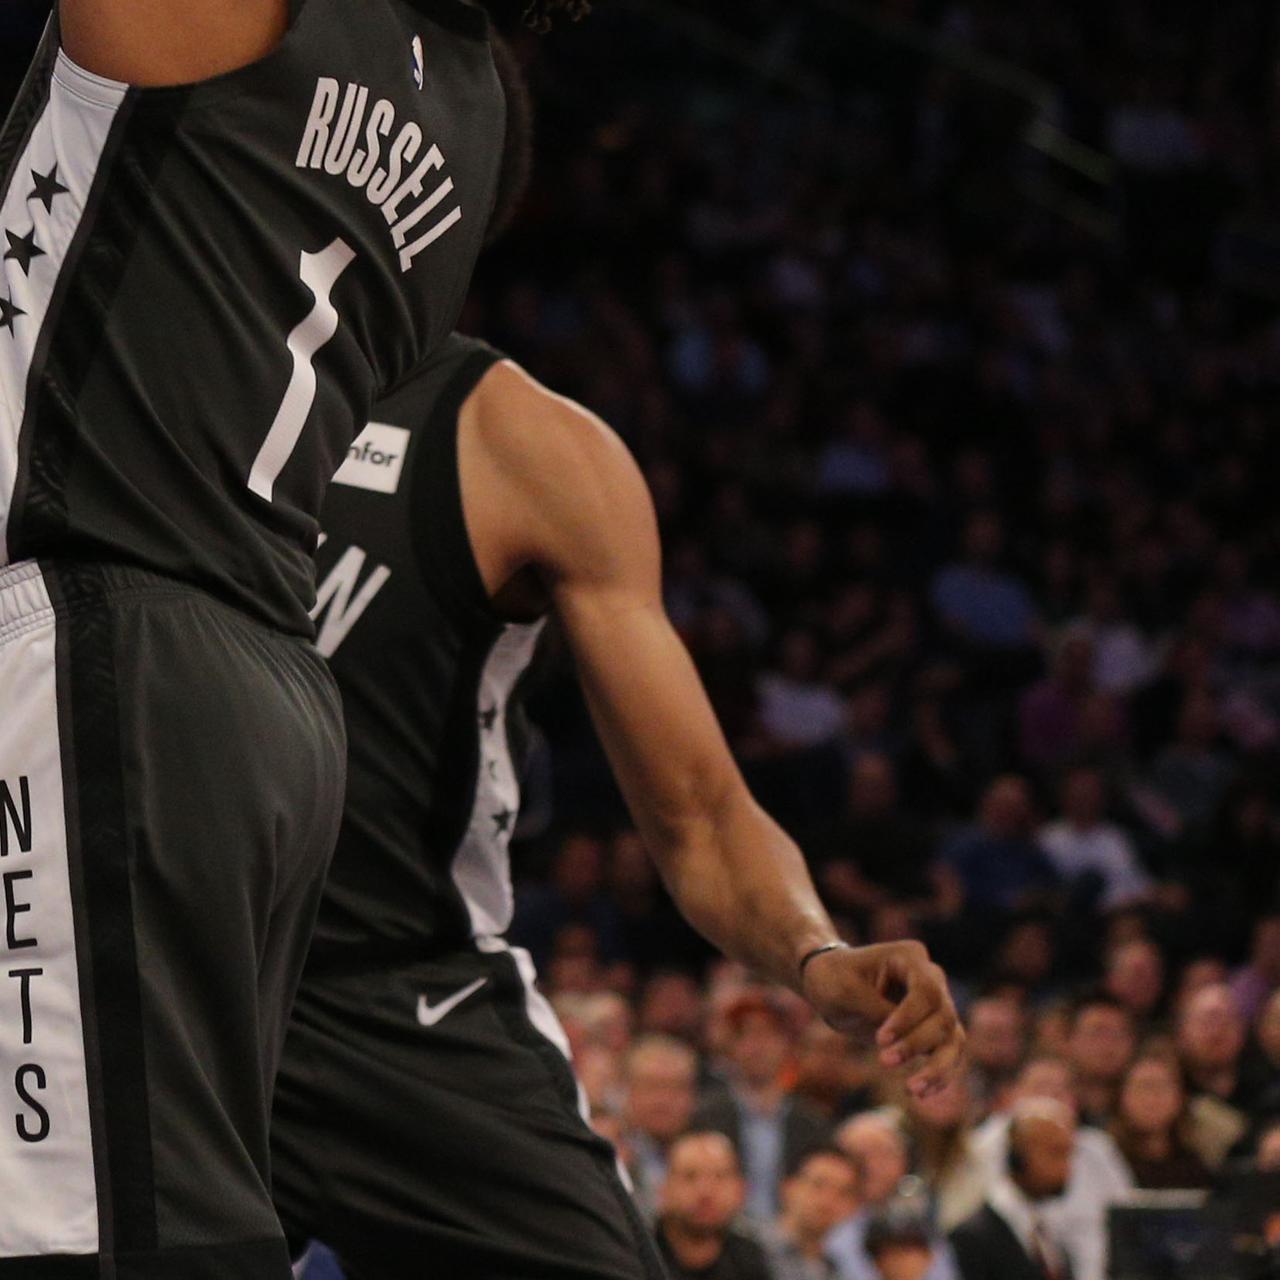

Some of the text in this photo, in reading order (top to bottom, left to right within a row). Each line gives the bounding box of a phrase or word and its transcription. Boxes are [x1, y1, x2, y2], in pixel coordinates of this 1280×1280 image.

[294, 76, 463, 274] RUSSELL
[246, 236, 358, 504] 1
[347, 441, 399, 468] nfor
